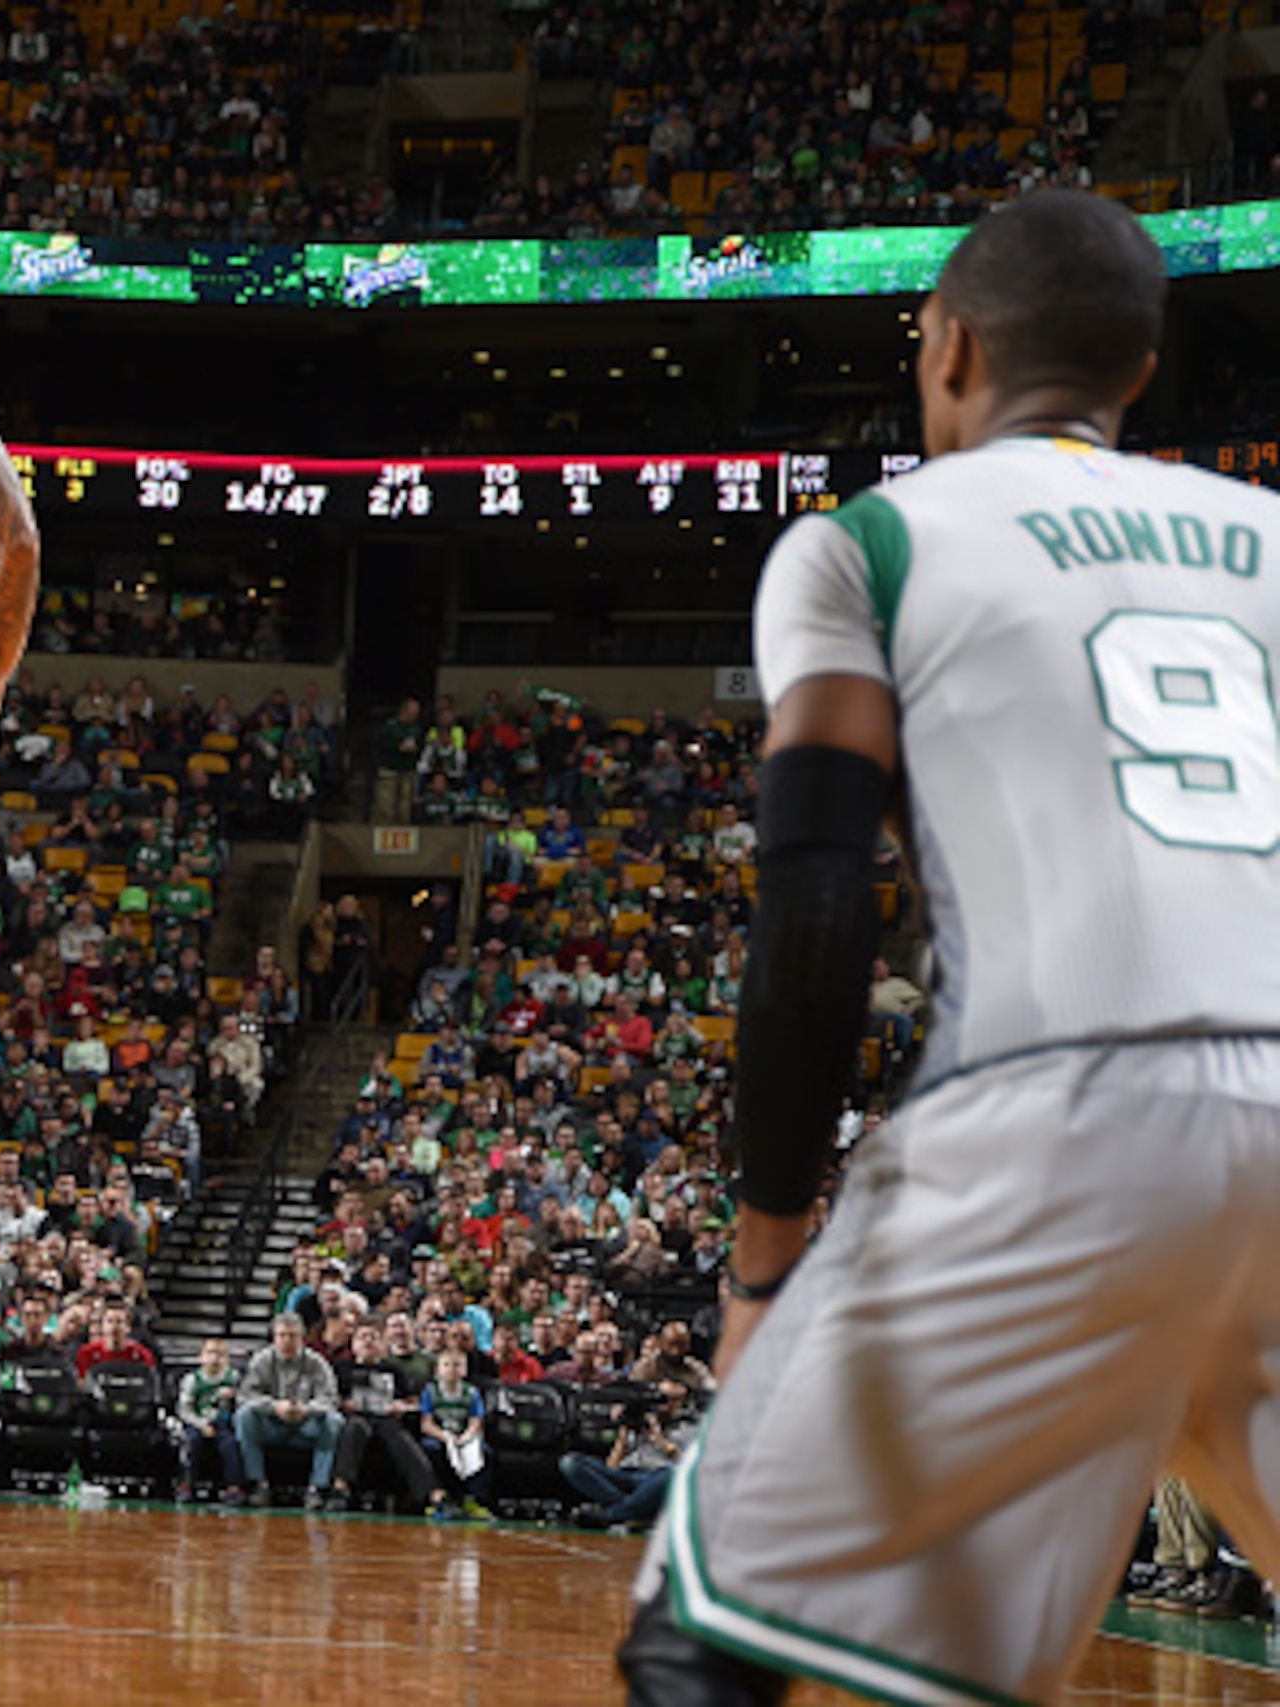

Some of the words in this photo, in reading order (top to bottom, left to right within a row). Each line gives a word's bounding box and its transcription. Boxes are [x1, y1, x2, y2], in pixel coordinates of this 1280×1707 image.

[260, 463, 296, 485] FG
[379, 464, 424, 486] 3PT
[482, 463, 518, 485] TO
[562, 463, 601, 485] STL
[637, 461, 686, 484] AST
[139, 480, 181, 509] 30
[225, 480, 328, 516] 14/47
[480, 485, 522, 516] 14
[570, 485, 593, 516] 1
[650, 485, 673, 514] 9
[717, 483, 762, 512] 31
[1019, 506, 1261, 578] RONDO
[1084, 609, 1280, 857] 9
